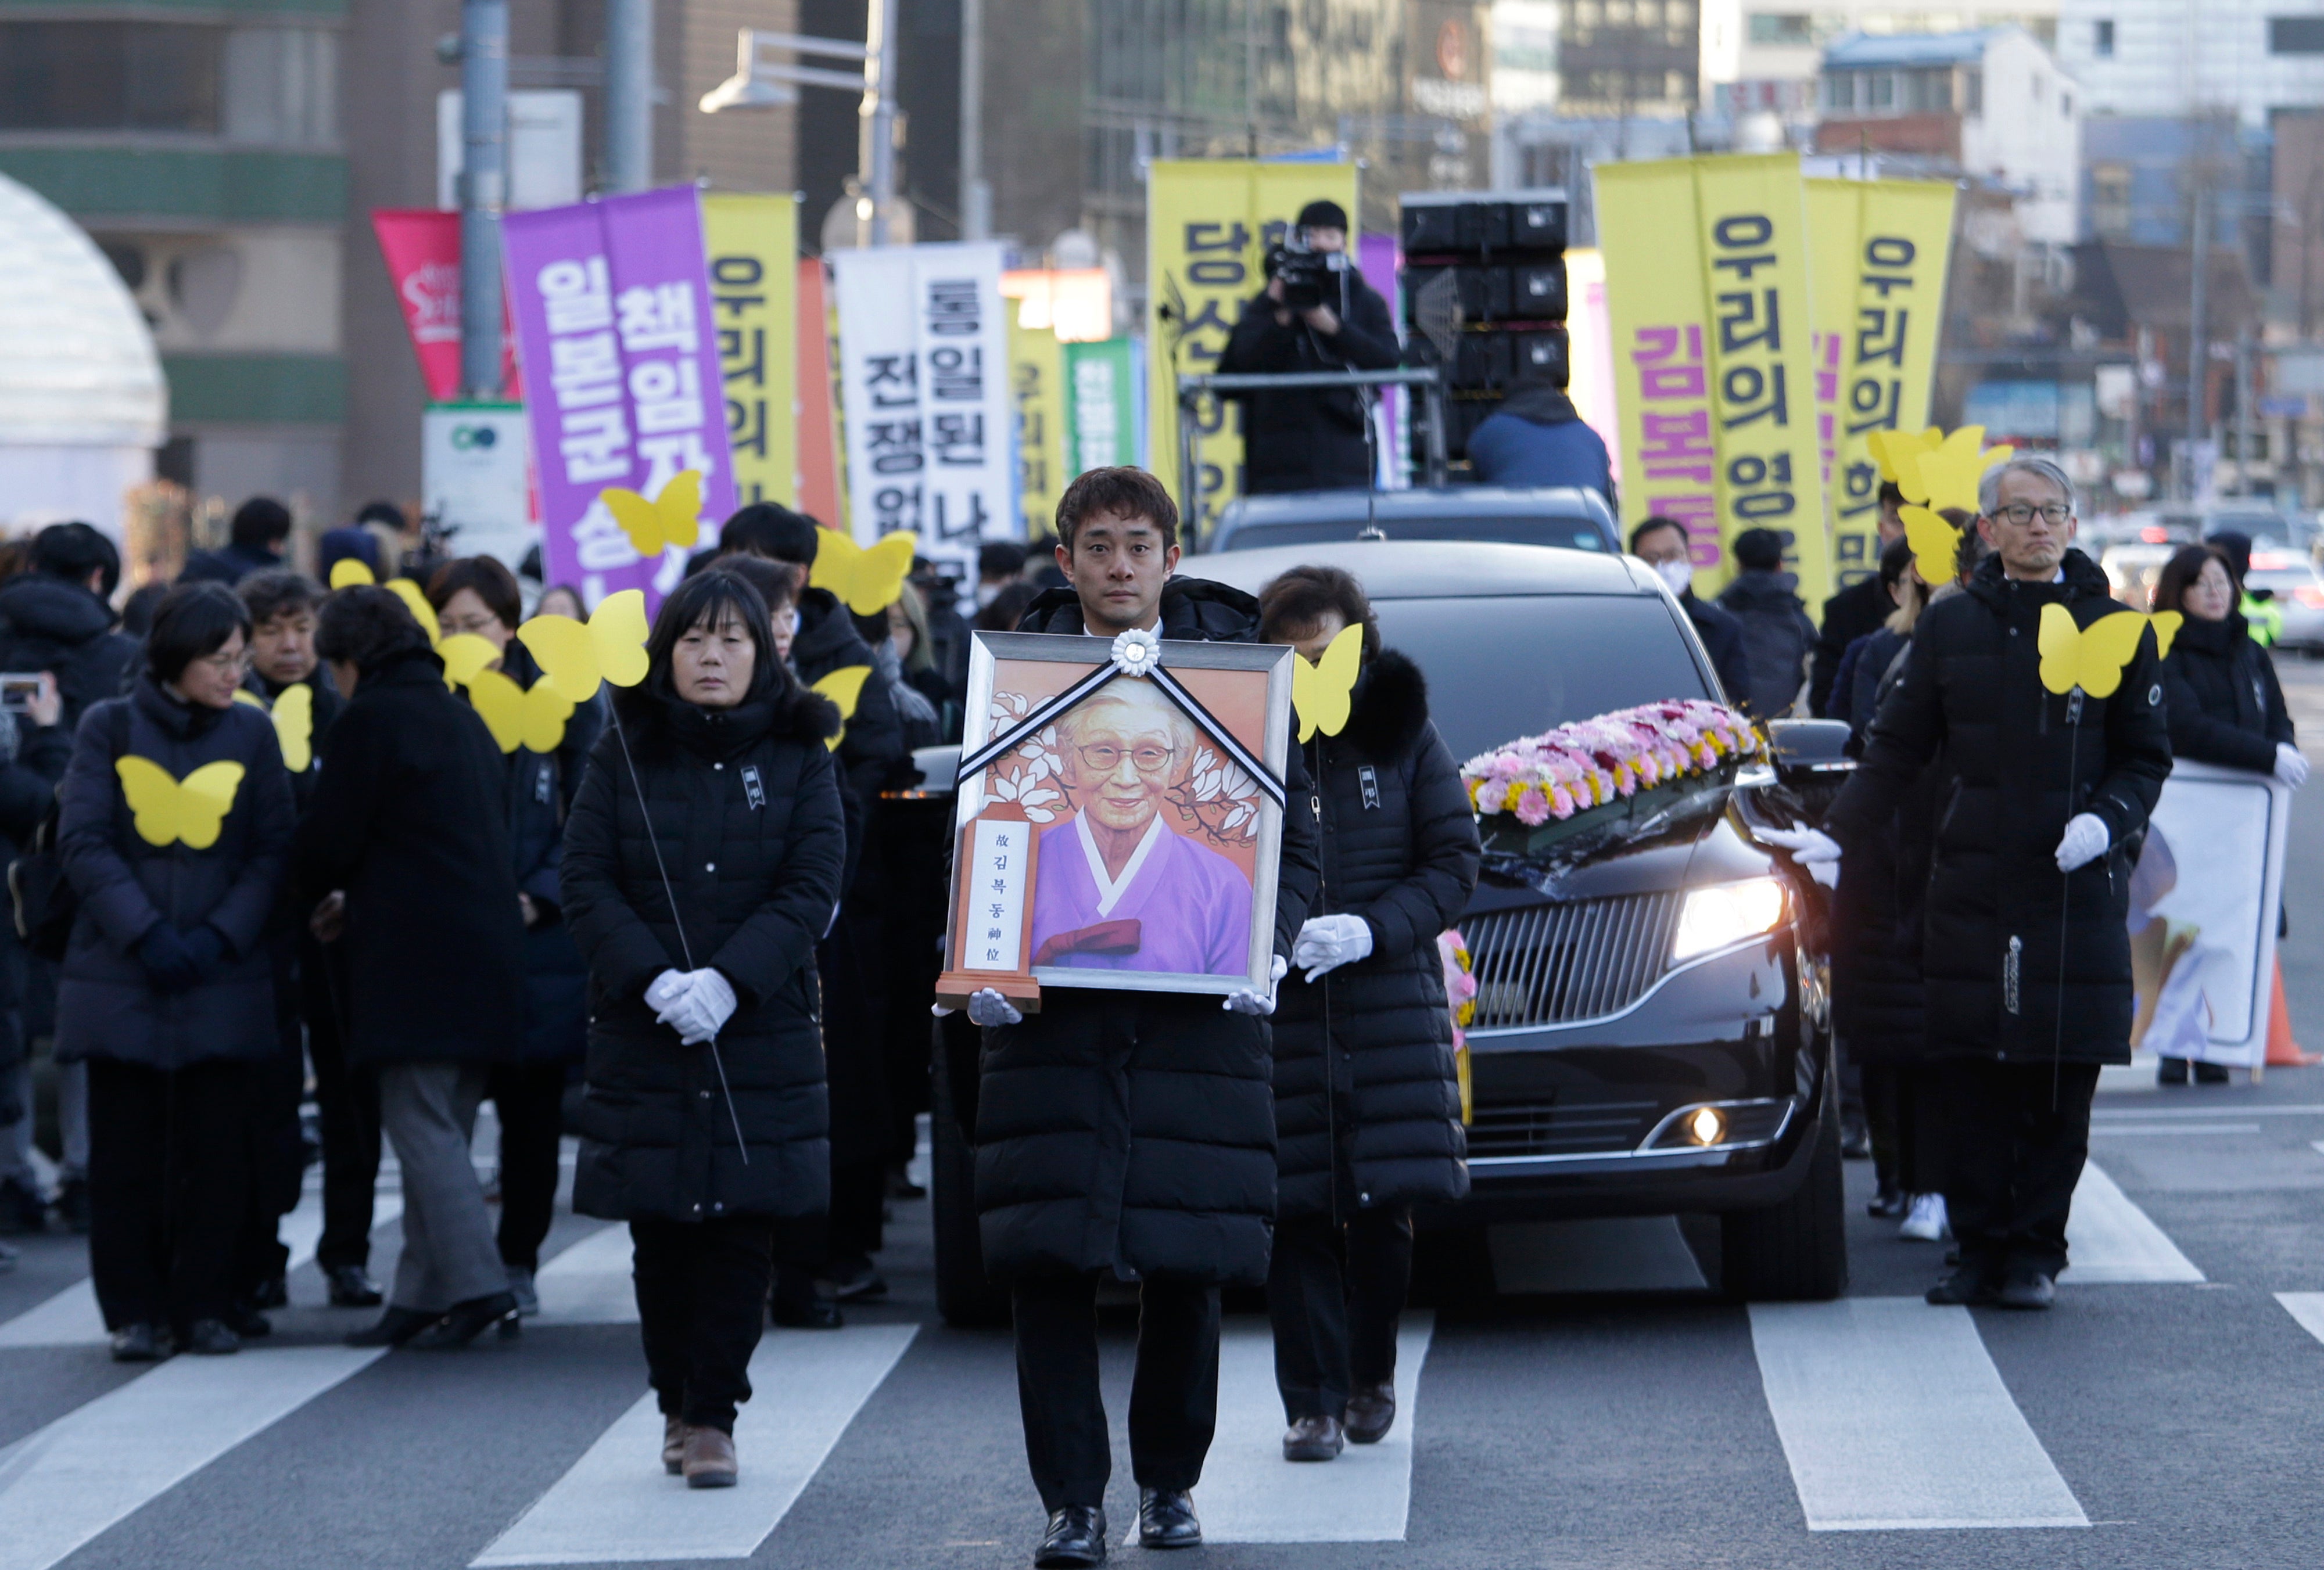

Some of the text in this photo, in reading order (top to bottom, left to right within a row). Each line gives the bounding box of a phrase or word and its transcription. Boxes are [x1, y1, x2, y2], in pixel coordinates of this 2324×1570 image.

[926, 278, 984, 465] 통일된
[1712, 215, 1787, 428] 우리의
[1844, 237, 1915, 434] 우리의
